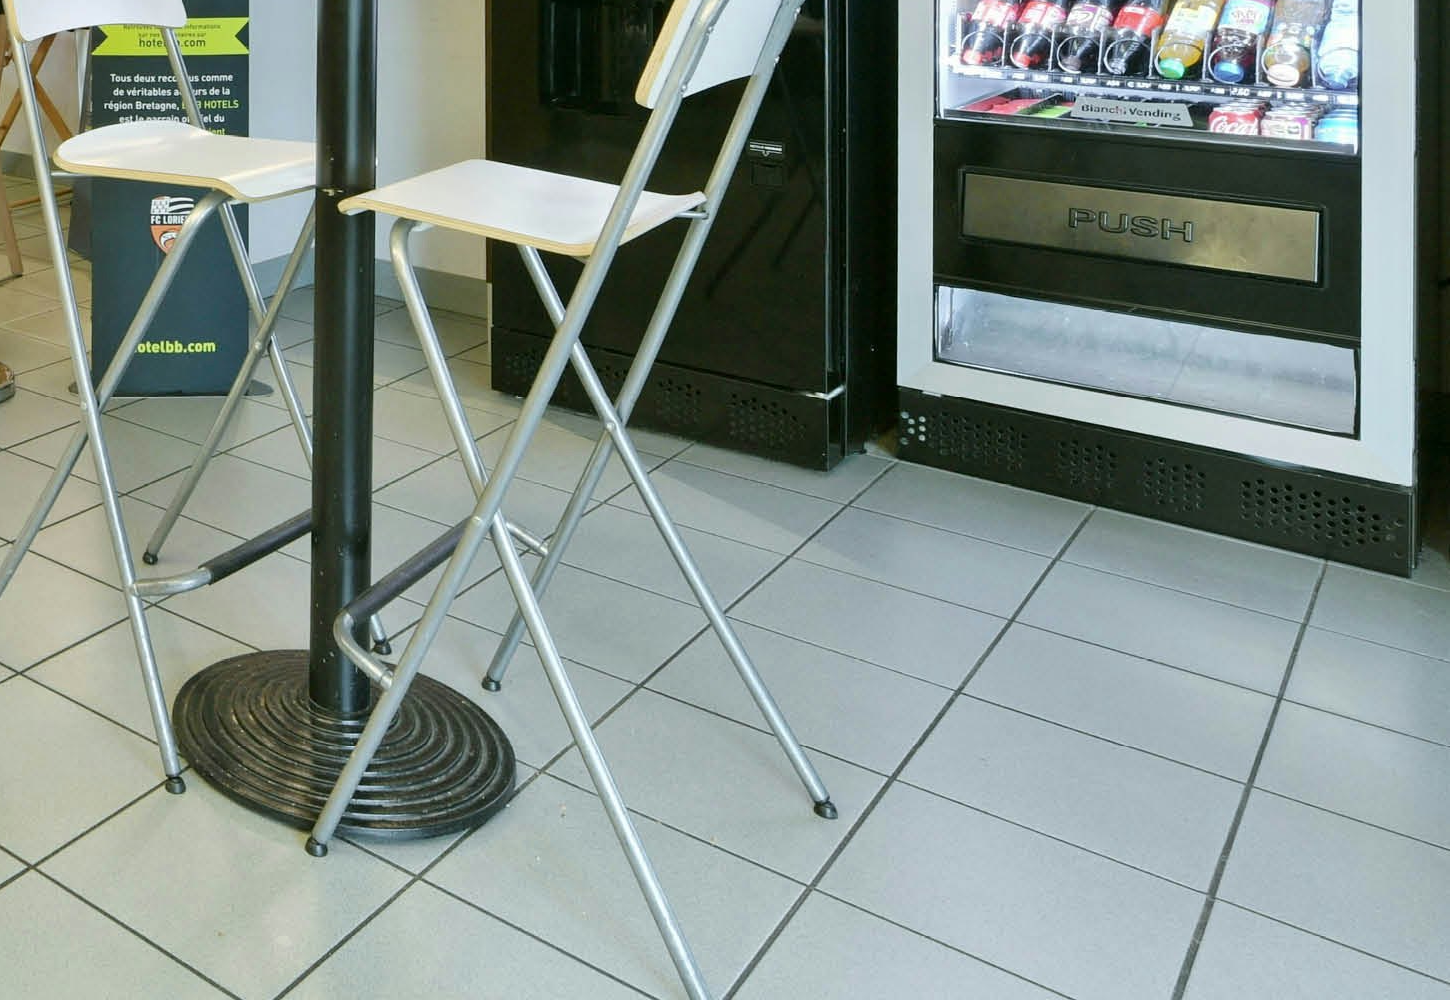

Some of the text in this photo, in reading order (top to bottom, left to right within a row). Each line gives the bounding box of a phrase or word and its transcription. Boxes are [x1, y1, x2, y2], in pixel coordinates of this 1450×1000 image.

[110, 74, 132, 83] Tous
[134, 73, 156, 83] deux
[201, 74, 233, 82] comme
[113, 87, 125, 96] de
[126, 87, 172, 96] véritables
[209, 87, 220, 95] de
[222, 87, 231, 96] la
[104, 101, 133, 112] région
[136, 101, 180, 112] Bretagne,
[204, 100, 239, 109] HOTELS
[214, 114, 225, 122] du
[1081, 104, 1181, 121] Bianchi Vending
[151, 215, 187, 225] FC LORIE
[1067, 207, 1195, 243] PUSH
[135, 341, 216, 353] otelbb.com
